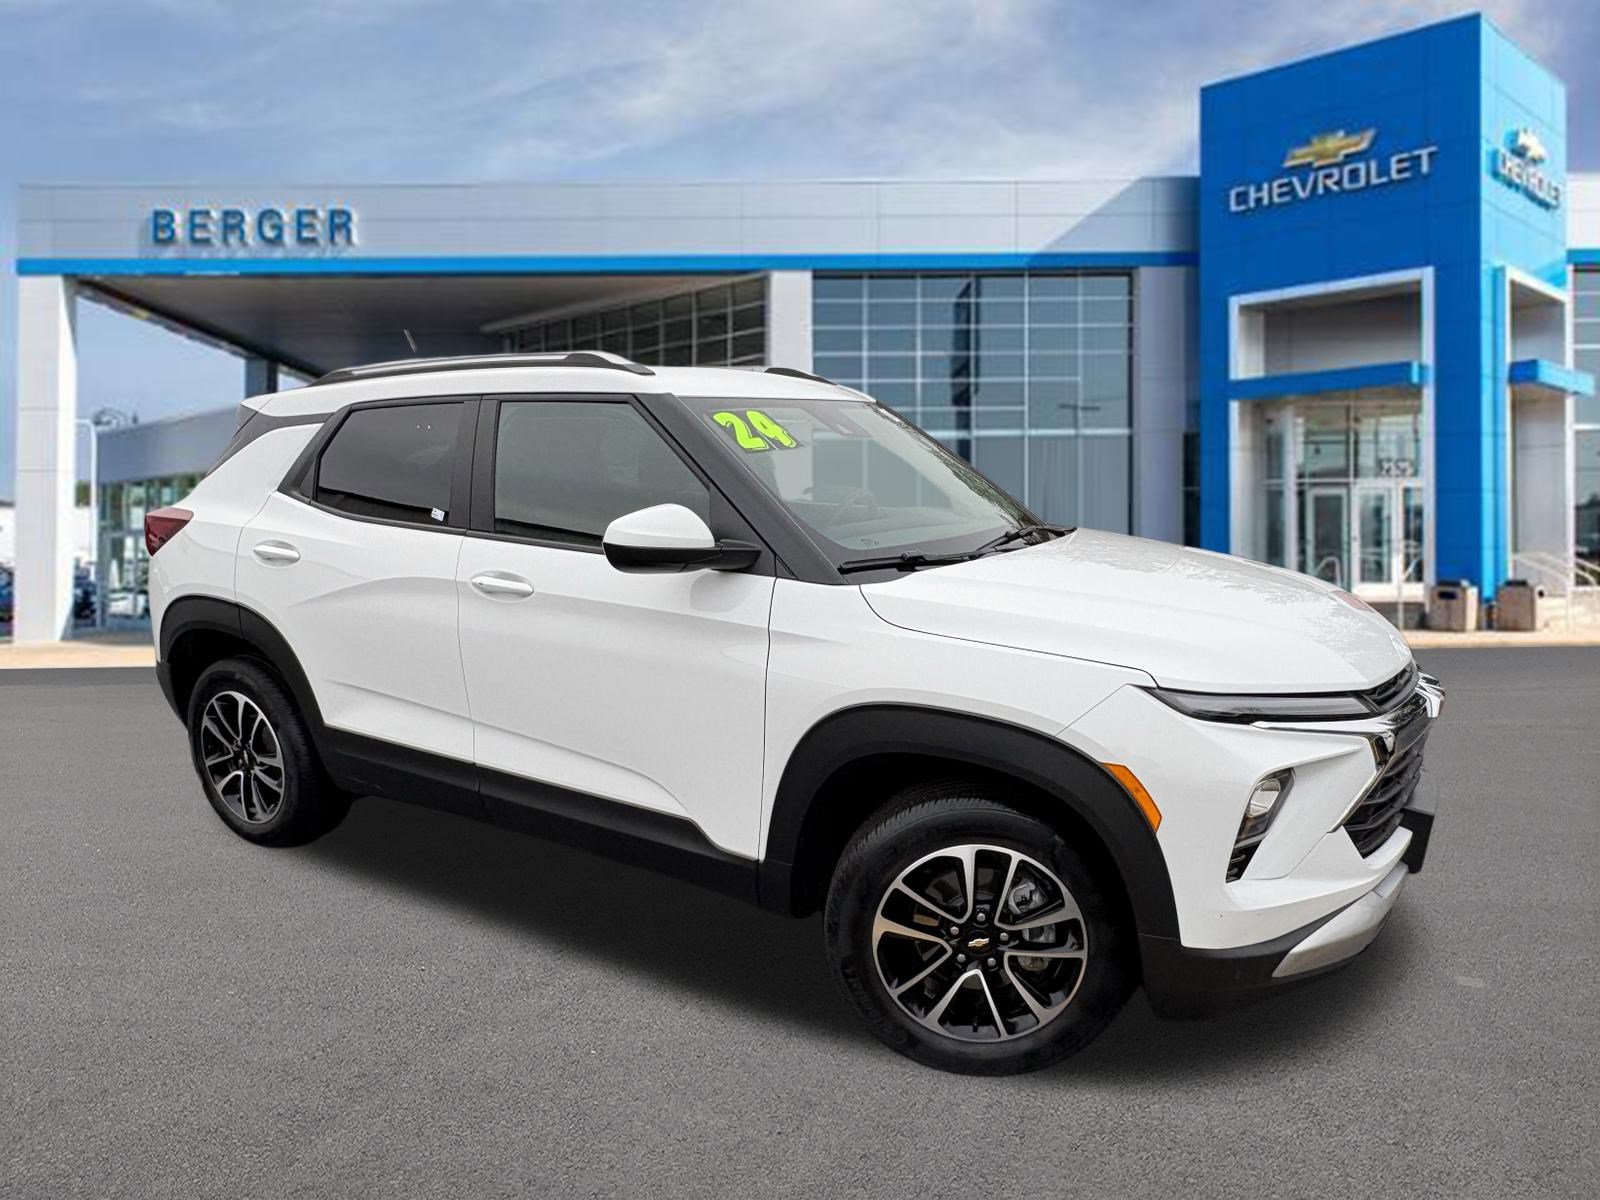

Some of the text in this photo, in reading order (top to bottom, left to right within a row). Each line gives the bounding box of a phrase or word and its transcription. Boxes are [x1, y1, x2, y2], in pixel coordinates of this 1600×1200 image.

[1229, 146, 1438, 212] CHEVROLET
[152, 208, 356, 246] BERGER
[712, 410, 797, 450] 24
